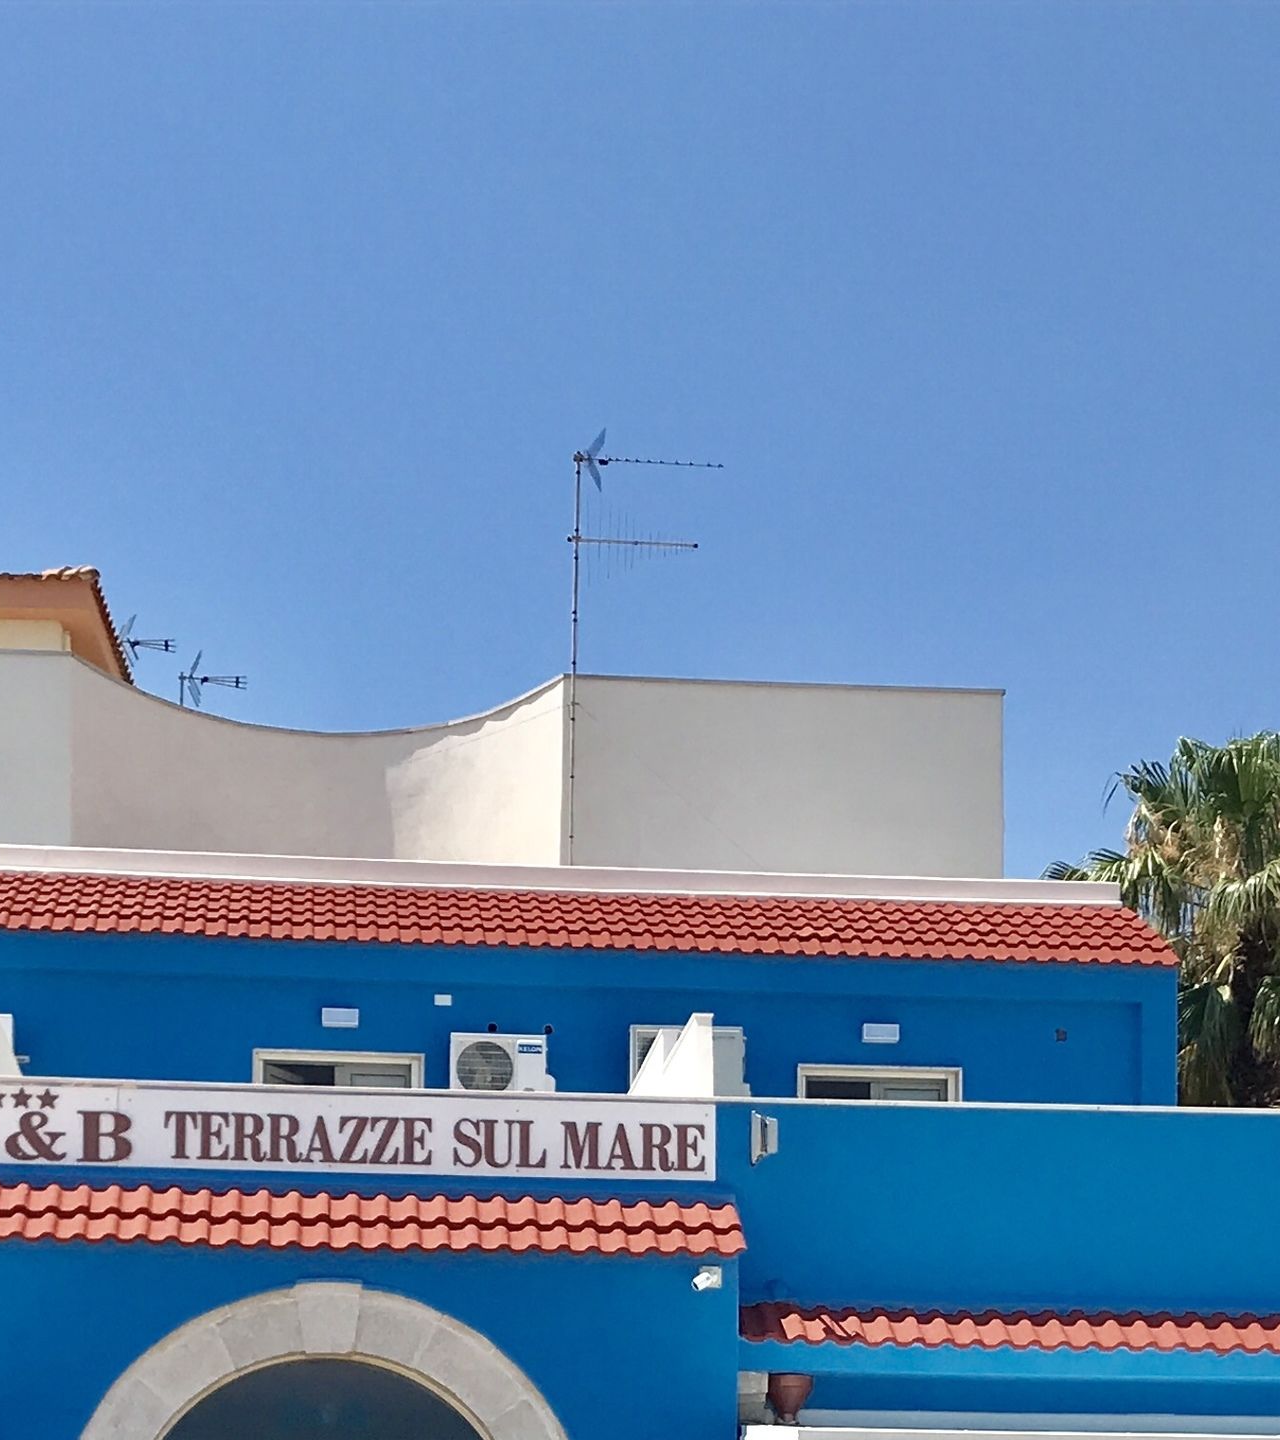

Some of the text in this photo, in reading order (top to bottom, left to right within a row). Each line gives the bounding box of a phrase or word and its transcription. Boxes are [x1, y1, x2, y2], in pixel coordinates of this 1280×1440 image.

[163, 1110, 433, 1166] TERRAZZE
[453, 1118, 547, 1169] SUL
[559, 1121, 706, 1172] MARE
